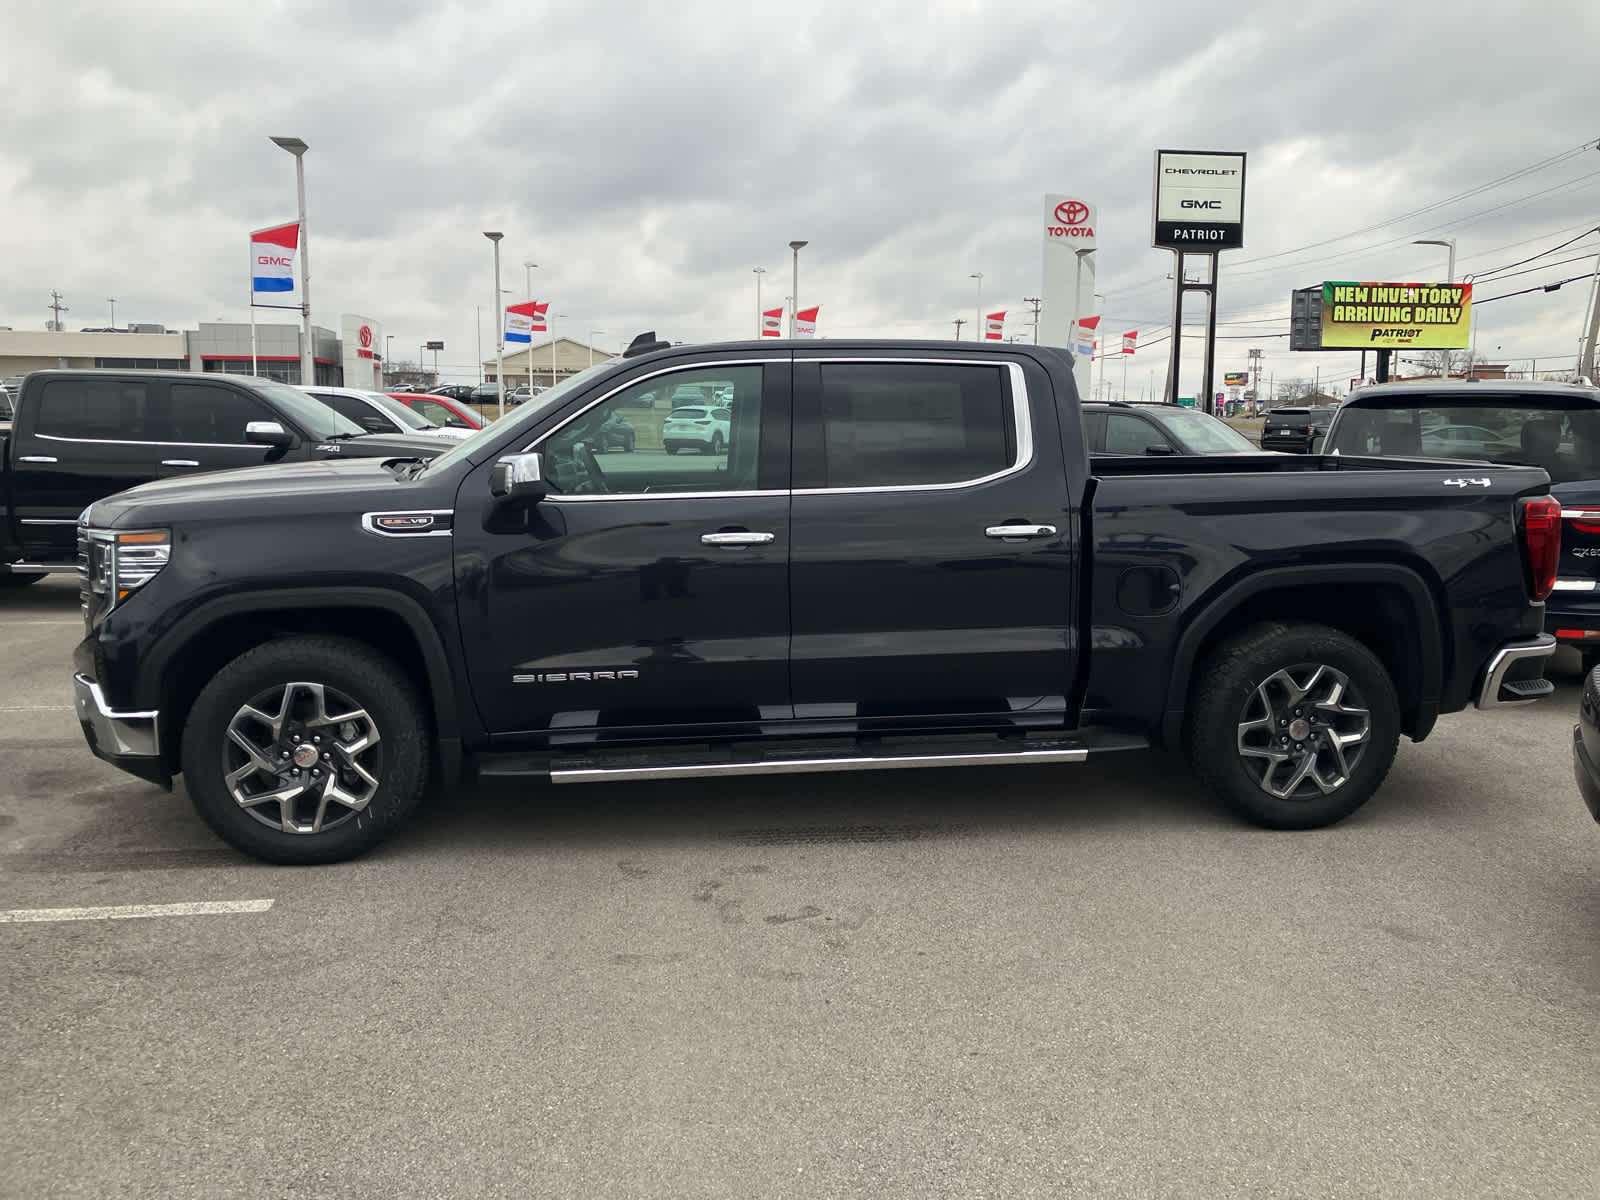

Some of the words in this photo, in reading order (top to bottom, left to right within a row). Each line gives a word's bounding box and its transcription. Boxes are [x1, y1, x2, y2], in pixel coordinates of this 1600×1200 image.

[1165, 168, 1238, 176] CHEVROLET
[1180, 200, 1222, 209] GMC
[1047, 226, 1095, 238] TOYOTA
[1174, 229, 1226, 240] PATRIOT
[257, 256, 292, 267] GMC
[1334, 287, 1369, 303] NEW
[1372, 287, 1463, 304] INVENTORY
[1333, 305, 1411, 322] ARRIVING
[1414, 306, 1462, 323] DAILY
[1370, 328, 1423, 341] PATRIOT
[511, 670, 640, 683] SIERRA
